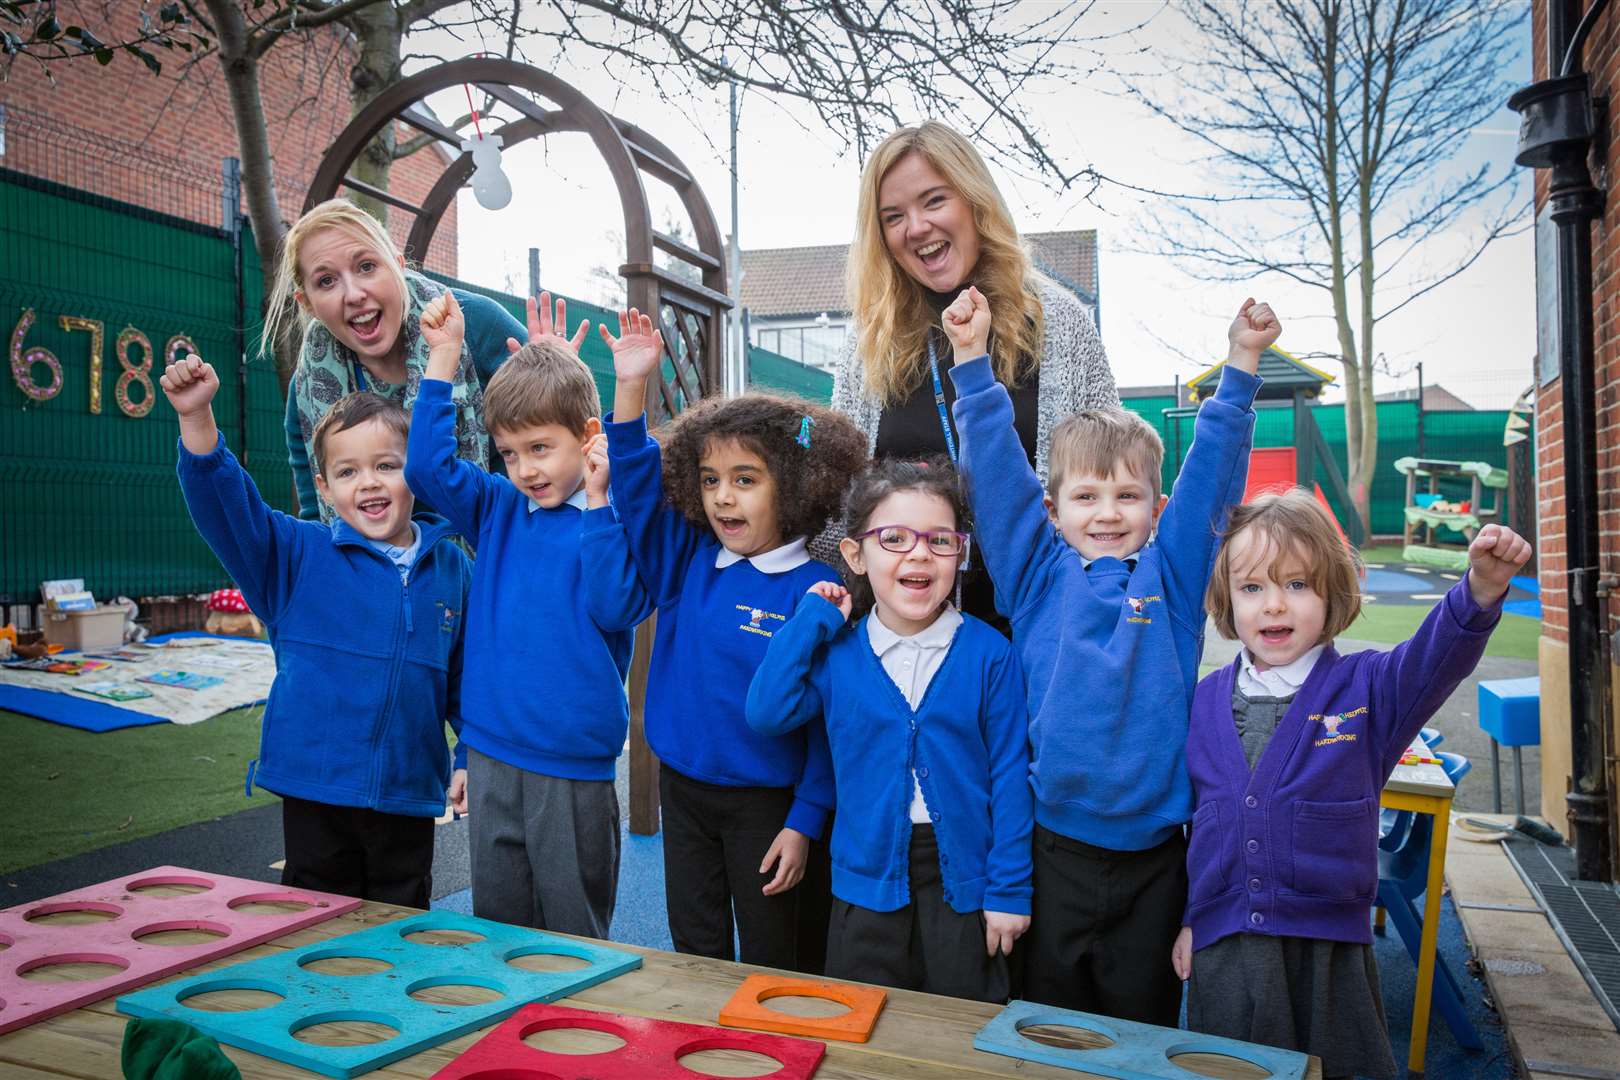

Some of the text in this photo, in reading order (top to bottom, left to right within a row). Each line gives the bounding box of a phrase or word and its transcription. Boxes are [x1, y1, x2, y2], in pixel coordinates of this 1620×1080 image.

[10, 307, 156, 418] 6 7 8
[1308, 713, 1321, 721] HAP
